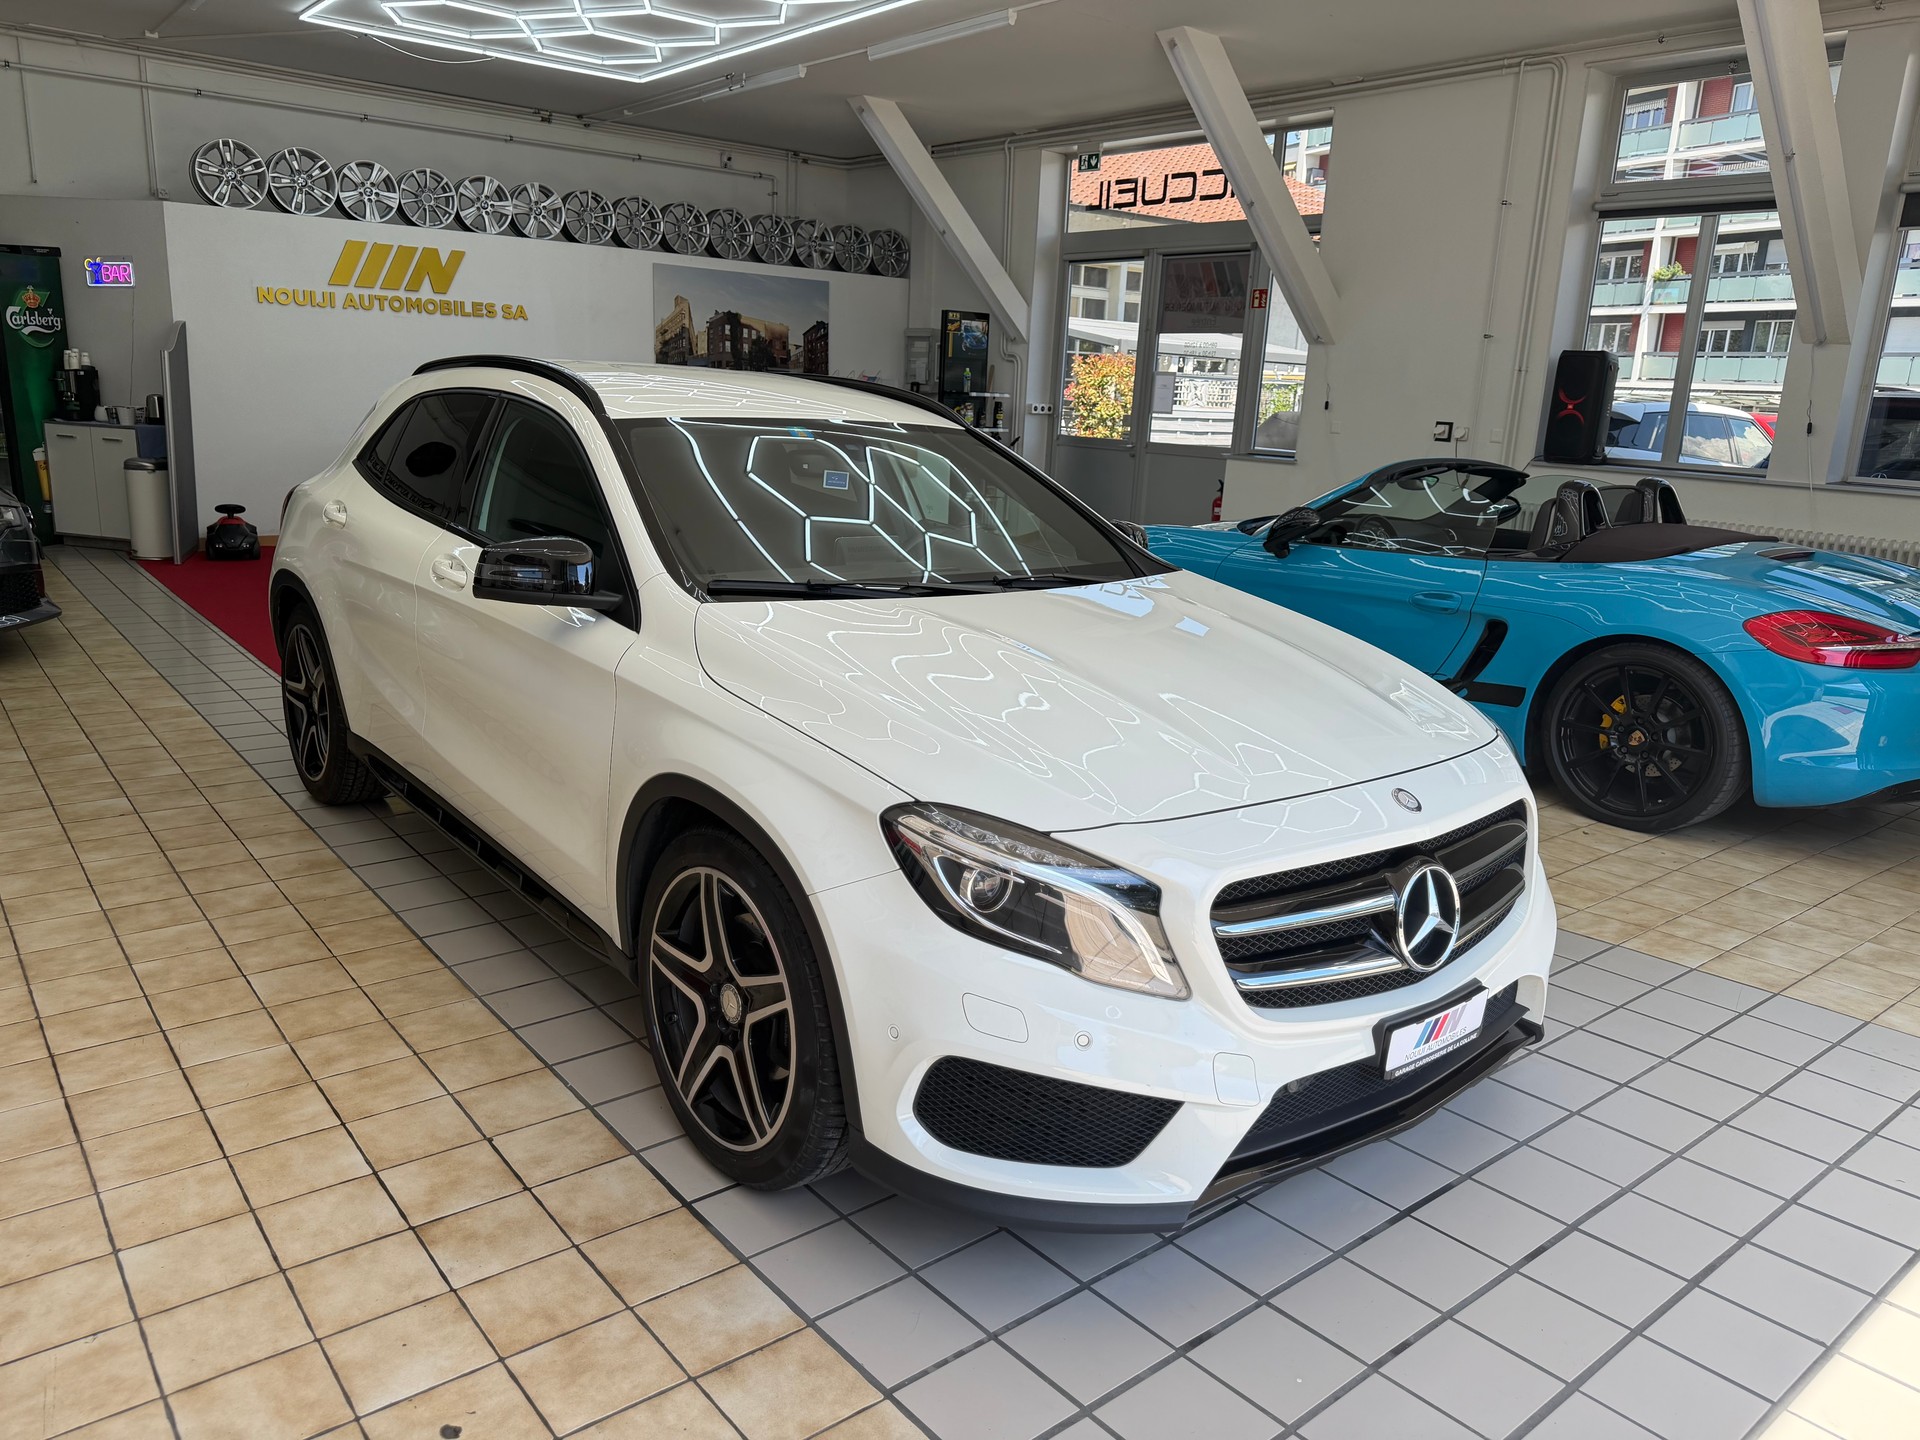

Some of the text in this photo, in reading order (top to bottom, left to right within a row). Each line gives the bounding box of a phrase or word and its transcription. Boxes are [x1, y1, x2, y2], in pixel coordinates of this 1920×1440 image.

[101, 264, 131, 283] BAR
[256, 286, 529, 321] NOUIJI AUTOMOBILES SA
[6, 306, 61, 333] Carlsberg
[1426, 1027, 1468, 1051] AUTOMOBILES
[1395, 1064, 1416, 1076] GARAGE
[1416, 1050, 1448, 1067] CARROSSERIE
